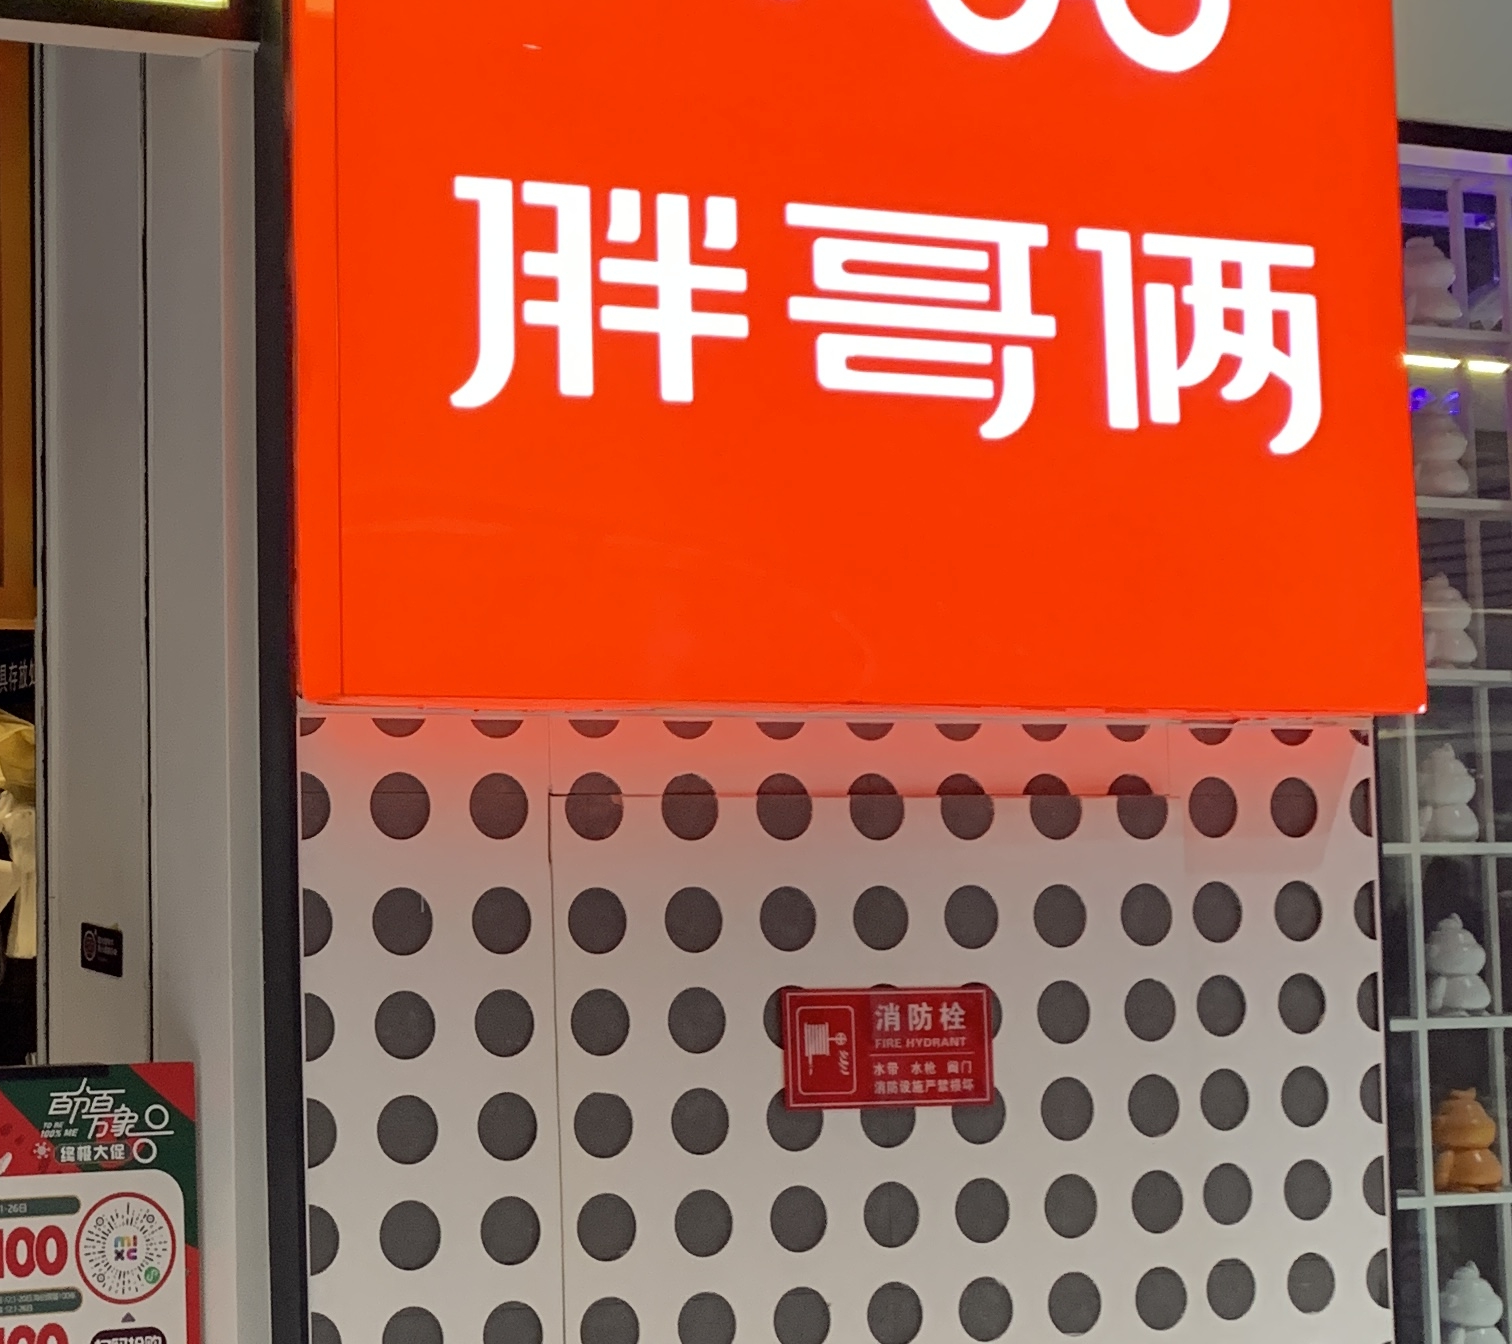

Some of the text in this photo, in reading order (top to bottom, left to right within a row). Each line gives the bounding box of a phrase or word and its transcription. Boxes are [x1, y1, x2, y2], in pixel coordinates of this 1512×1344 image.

[450, 175, 1323, 455] 胖哥俩
[874, 1001, 966, 1032] 消防栓
[875, 1036, 968, 1049] FIRE HYDRANT
